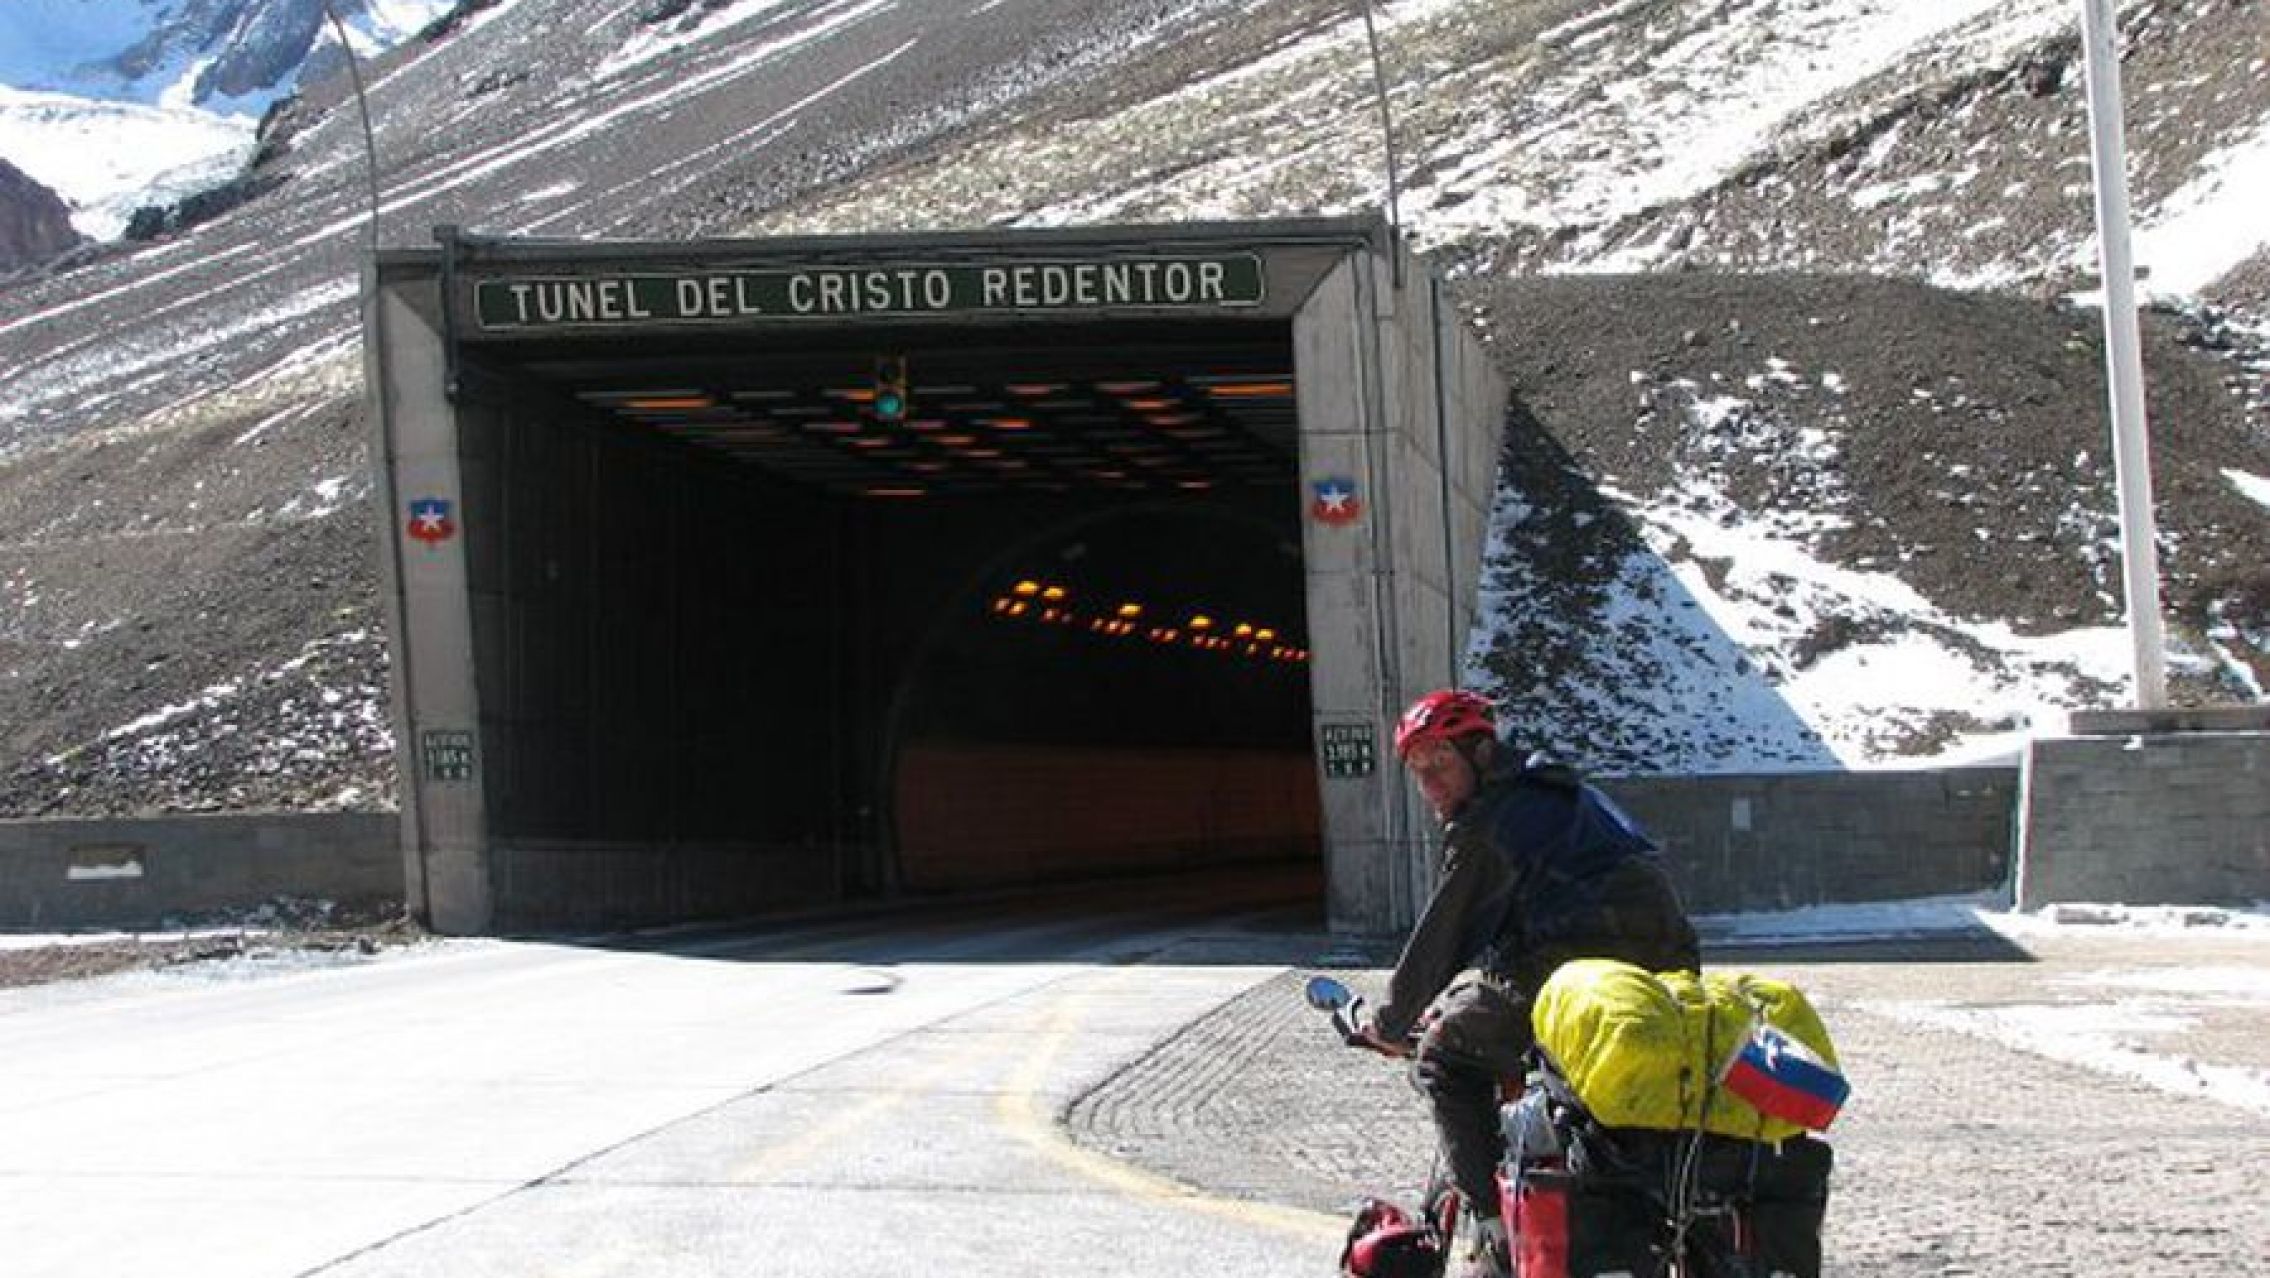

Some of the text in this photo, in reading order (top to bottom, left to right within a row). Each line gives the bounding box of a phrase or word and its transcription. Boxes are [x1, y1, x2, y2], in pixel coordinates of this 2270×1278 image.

[511, 262, 1225, 322] TUNEL DEL CRISTO REDENTOR
